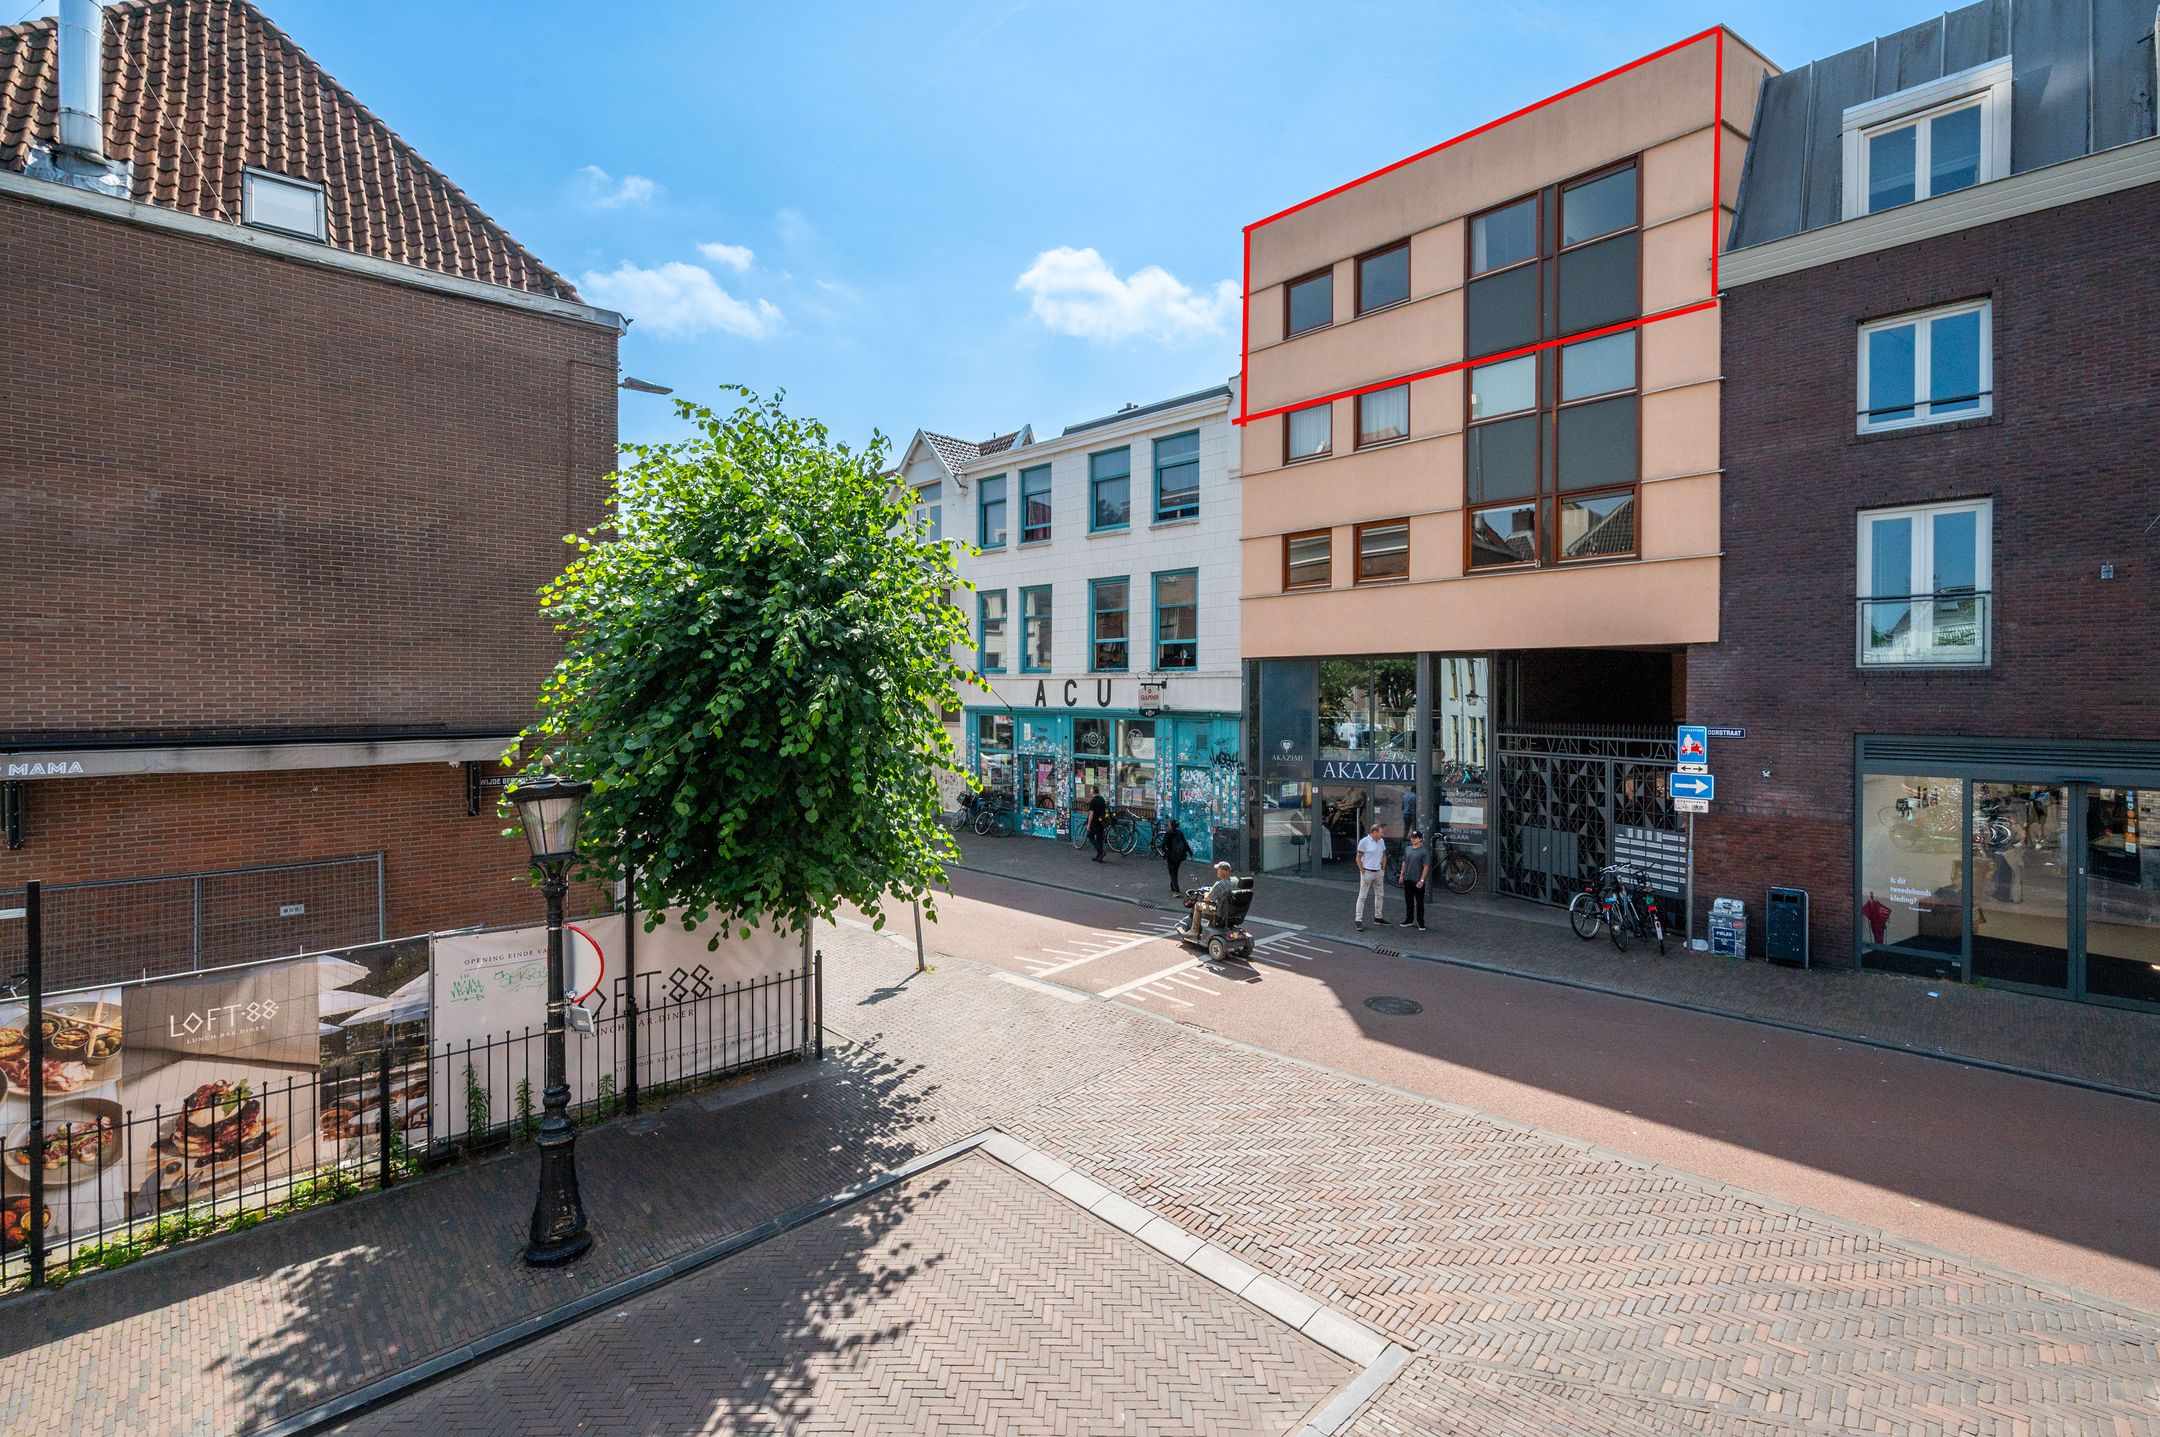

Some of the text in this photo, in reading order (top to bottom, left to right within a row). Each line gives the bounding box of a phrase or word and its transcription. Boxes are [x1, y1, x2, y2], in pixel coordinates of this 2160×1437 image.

[1034, 678, 1112, 708] ACU
[1707, 729, 1742, 737] OORSTRAAT
[1507, 735, 1678, 761] HOF VAN SINT JAN
[1271, 754, 1303, 762] AKAZIMI
[8, 761, 84, 776] MAMA
[1322, 761, 1416, 781] AKAZIMI
[480, 778, 501, 786] WIJDE
[1890, 895, 1917, 905] kleding?
[464, 955, 505, 965] OPENING
[508, 950, 533, 959] EINDE
